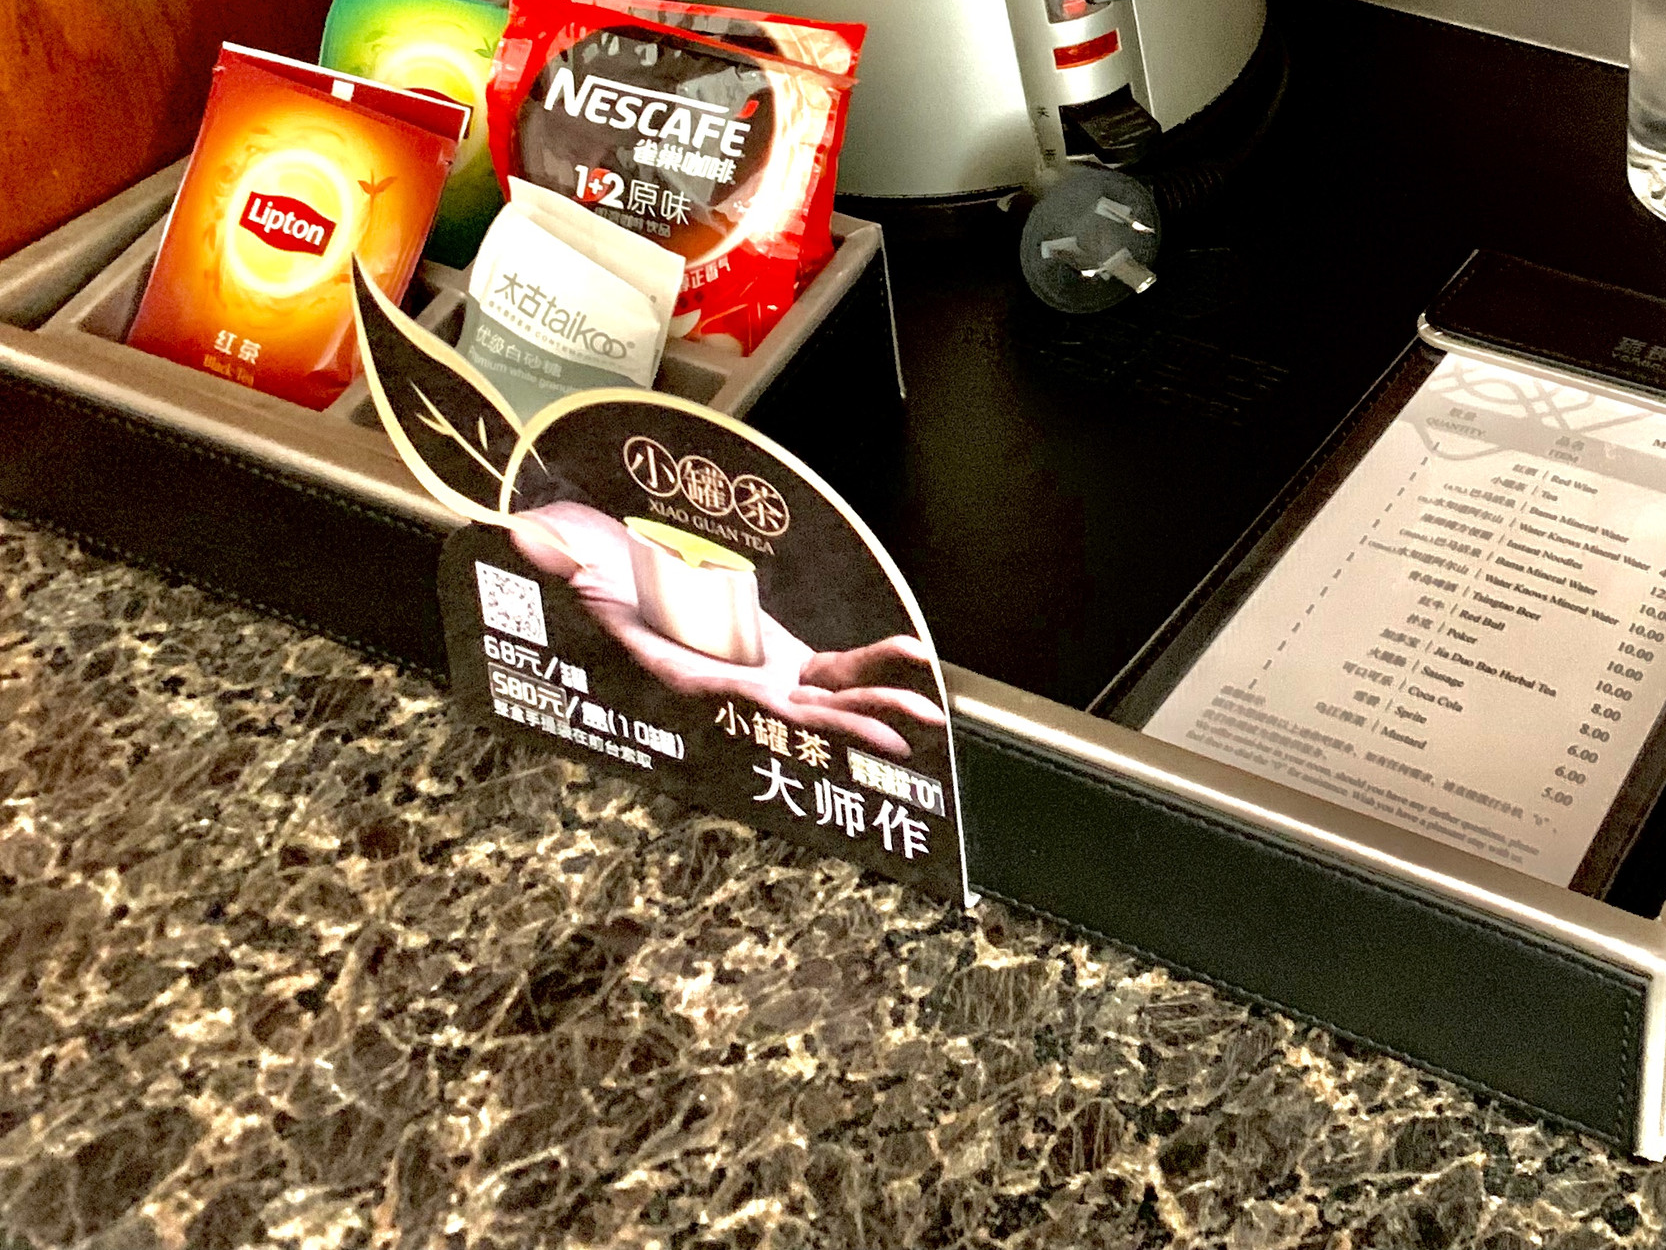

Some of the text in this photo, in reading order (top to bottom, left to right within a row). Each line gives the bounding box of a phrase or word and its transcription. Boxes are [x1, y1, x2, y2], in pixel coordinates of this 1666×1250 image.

[633, 138, 736, 184] 雀巢咖啡
[248, 197, 325, 246] Lipton
[214, 330, 262, 365] 红茶
[475, 323, 563, 378] 优级白砂糖
[1426, 416, 1486, 438] QUANTITY
[628, 441, 787, 533] 小罐茶
[1539, 490, 1560, 501] Tea
[1549, 474, 1572, 486] Red
[1571, 481, 1599, 494] Wine
[649, 497, 775, 556] XIAO GUAN TEA
[1505, 539, 1542, 556] Instant
[1541, 550, 1585, 570] Noodles
[1517, 522, 1547, 537] Water
[1546, 532, 1583, 548] Knows
[1581, 542, 1622, 561] Mineral
[1620, 555, 1652, 571] Water
[1528, 506, 1559, 521] Bama
[1558, 515, 1599, 533] Mineral
[1598, 528, 1630, 543] Water
[1494, 556, 1526, 572] Bama
[1525, 566, 1567, 585] Mineral
[1566, 579, 1599, 596] Water
[1469, 590, 1516, 613] Tsingtao
[1515, 606, 1542, 621] Beer
[1616, 641, 1656, 662] 10.00
[1482, 574, 1513, 589] Water
[1512, 583, 1550, 601] Knows
[1548, 595, 1589, 615] Mineral
[1588, 609, 1621, 626] Water
[1627, 622, 1666, 643] 10.00
[483, 634, 589, 694] 68元/罐
[1445, 627, 1478, 645] Poker
[1594, 680, 1634, 701] 10.00
[1457, 609, 1482, 623] Red
[1481, 617, 1506, 631] Bull
[1605, 660, 1645, 682] 10.00
[1418, 665, 1467, 689] Sausage
[1577, 723, 1612, 743] 8.00
[1432, 646, 1452, 659] Jia
[1450, 652, 1475, 667] Duo
[1474, 661, 1499, 676] Bao
[1498, 669, 1536, 688] Herbal
[1535, 683, 1559, 697] Tea
[1588, 702, 1622, 722] 8.00
[715, 700, 832, 769] 小罐茶
[1391, 705, 1429, 725] Sprite
[1552, 764, 1587, 785] 6.00
[1406, 685, 1437, 702] Coca
[1435, 695, 1465, 712] Cola
[1564, 744, 1600, 764] 6.00
[1379, 725, 1428, 750] Mustard
[1539, 786, 1575, 807] 5.00
[752, 757, 930, 859] 大师作
